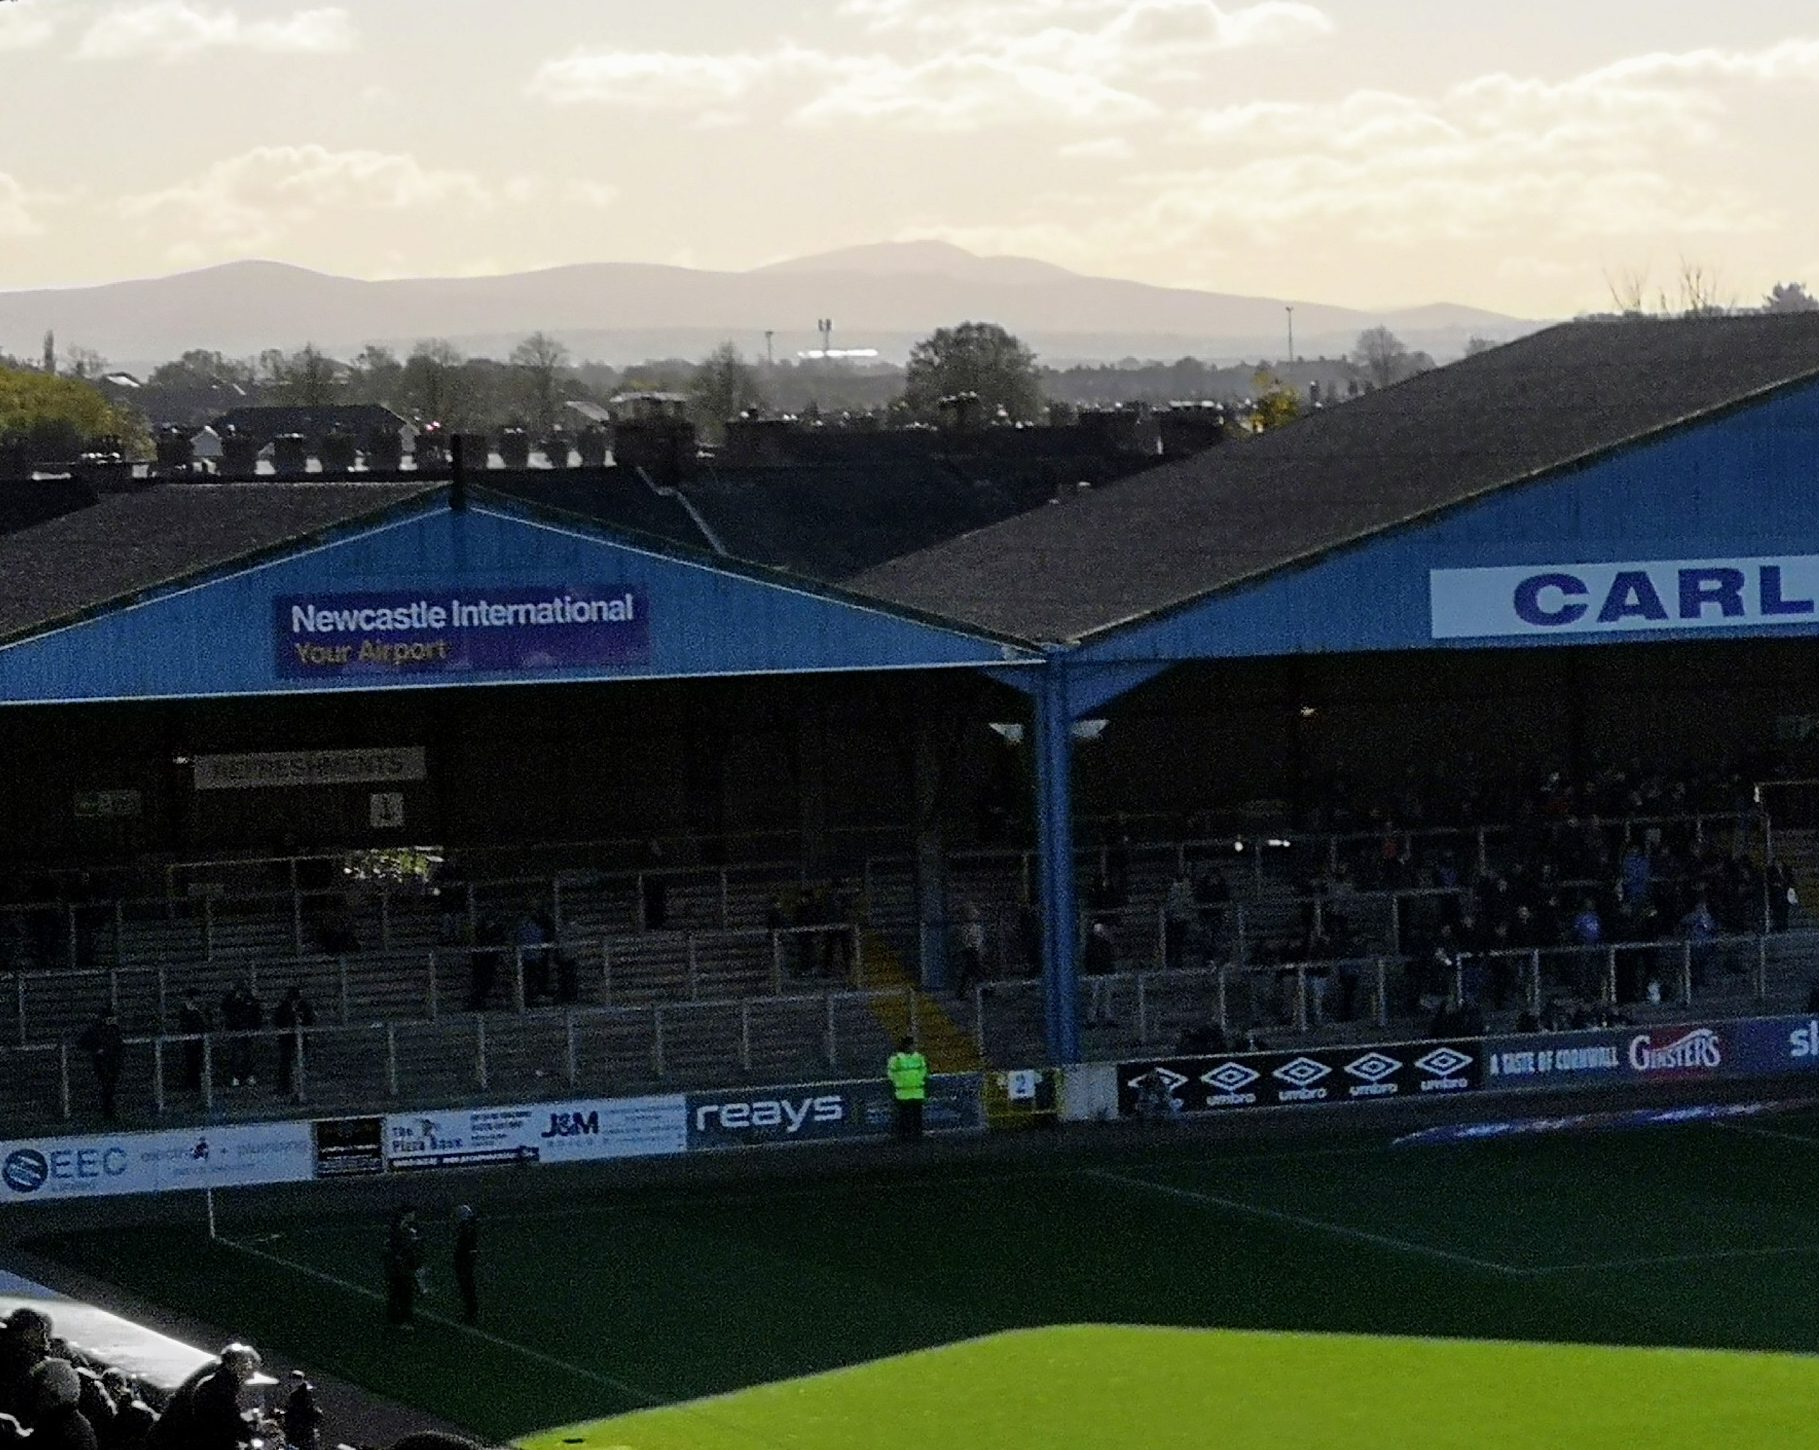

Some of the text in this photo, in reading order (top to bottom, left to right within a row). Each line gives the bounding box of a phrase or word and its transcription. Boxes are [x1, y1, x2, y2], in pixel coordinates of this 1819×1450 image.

[291, 592, 635, 634] Newcastle International
[294, 637, 452, 667] Your Airport
[1490, 1046, 1620, 1076] A TASTE OF CORNWALL
[1277, 1085, 1328, 1102] umbro
[1349, 1080, 1399, 1098] umbro
[1420, 1075, 1469, 1092] umbro
[1206, 1090, 1254, 1108] umbro
[541, 1110, 599, 1138] J&M
[696, 1095, 845, 1133] reays
[50, 1147, 126, 1179] EEC
